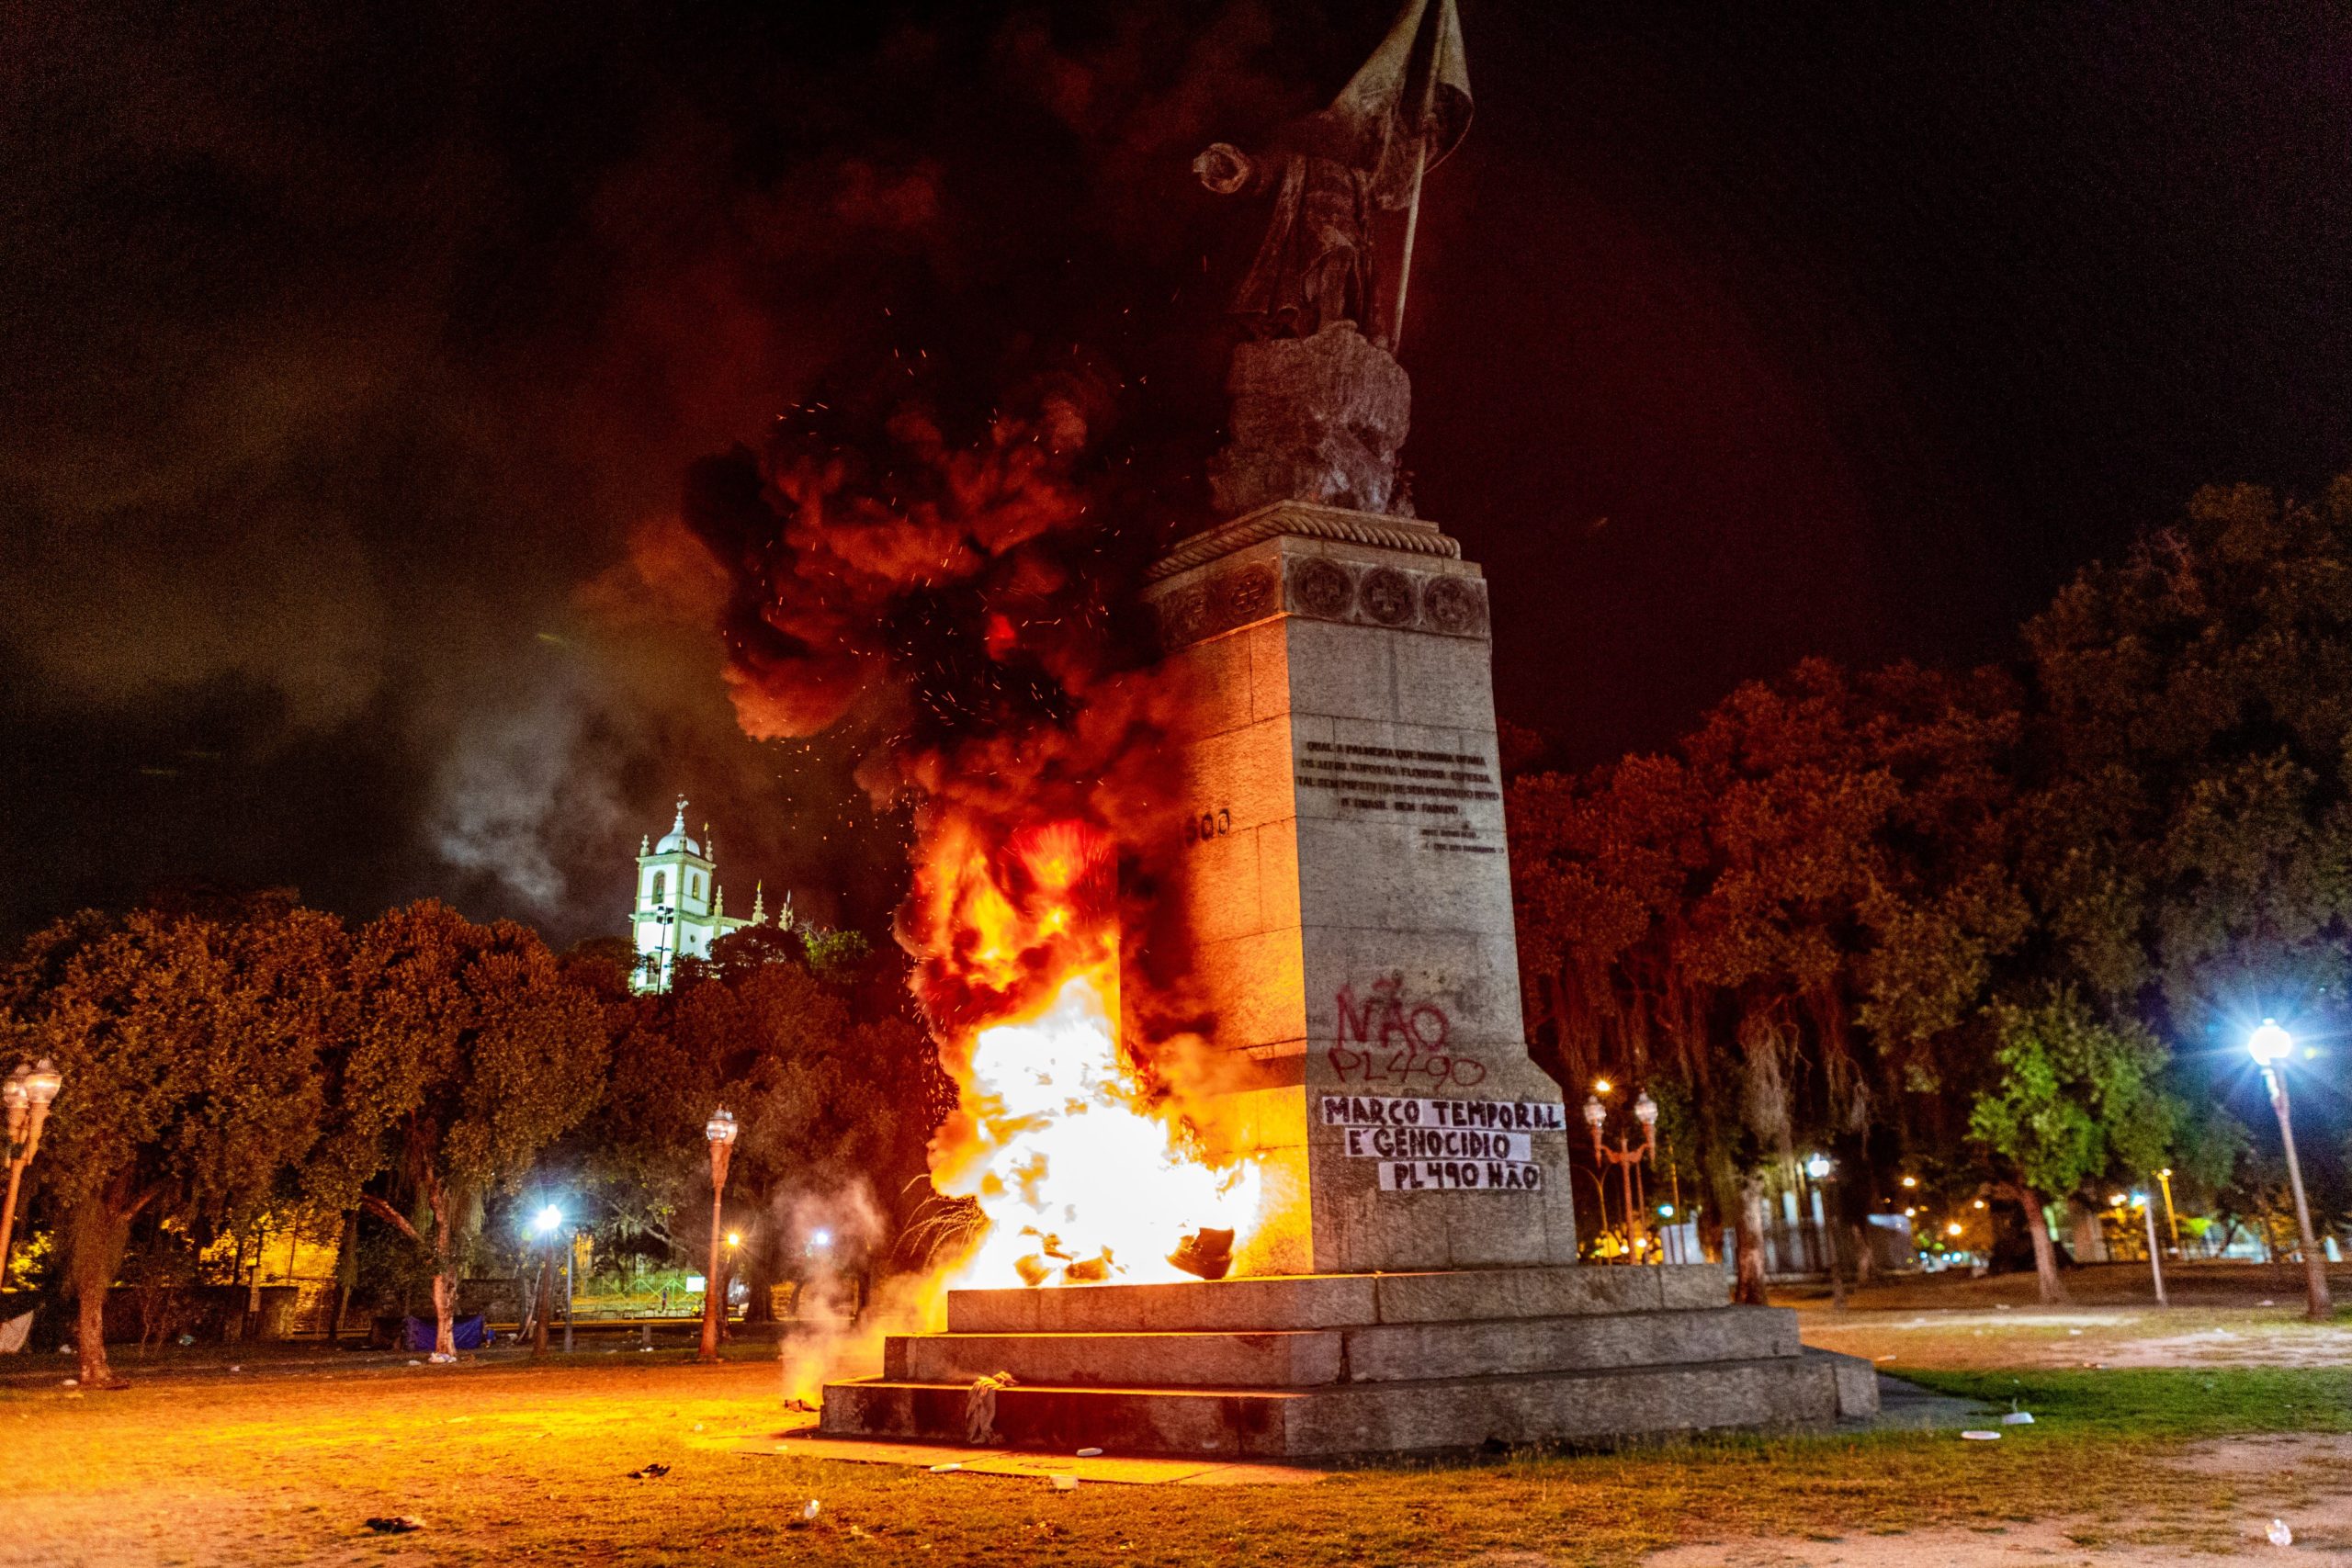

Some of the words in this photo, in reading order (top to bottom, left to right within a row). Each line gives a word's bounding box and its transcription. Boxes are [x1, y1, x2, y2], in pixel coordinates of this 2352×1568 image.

[1337, 978, 1449, 1055] NÃO
[1323, 1098, 1420, 1125] MARCO
[1431, 1101, 1561, 1129] TEMPORAL
[1373, 1129, 1511, 1159] GENOCIDIO
[1487, 1163, 1539, 1189] NÃO
